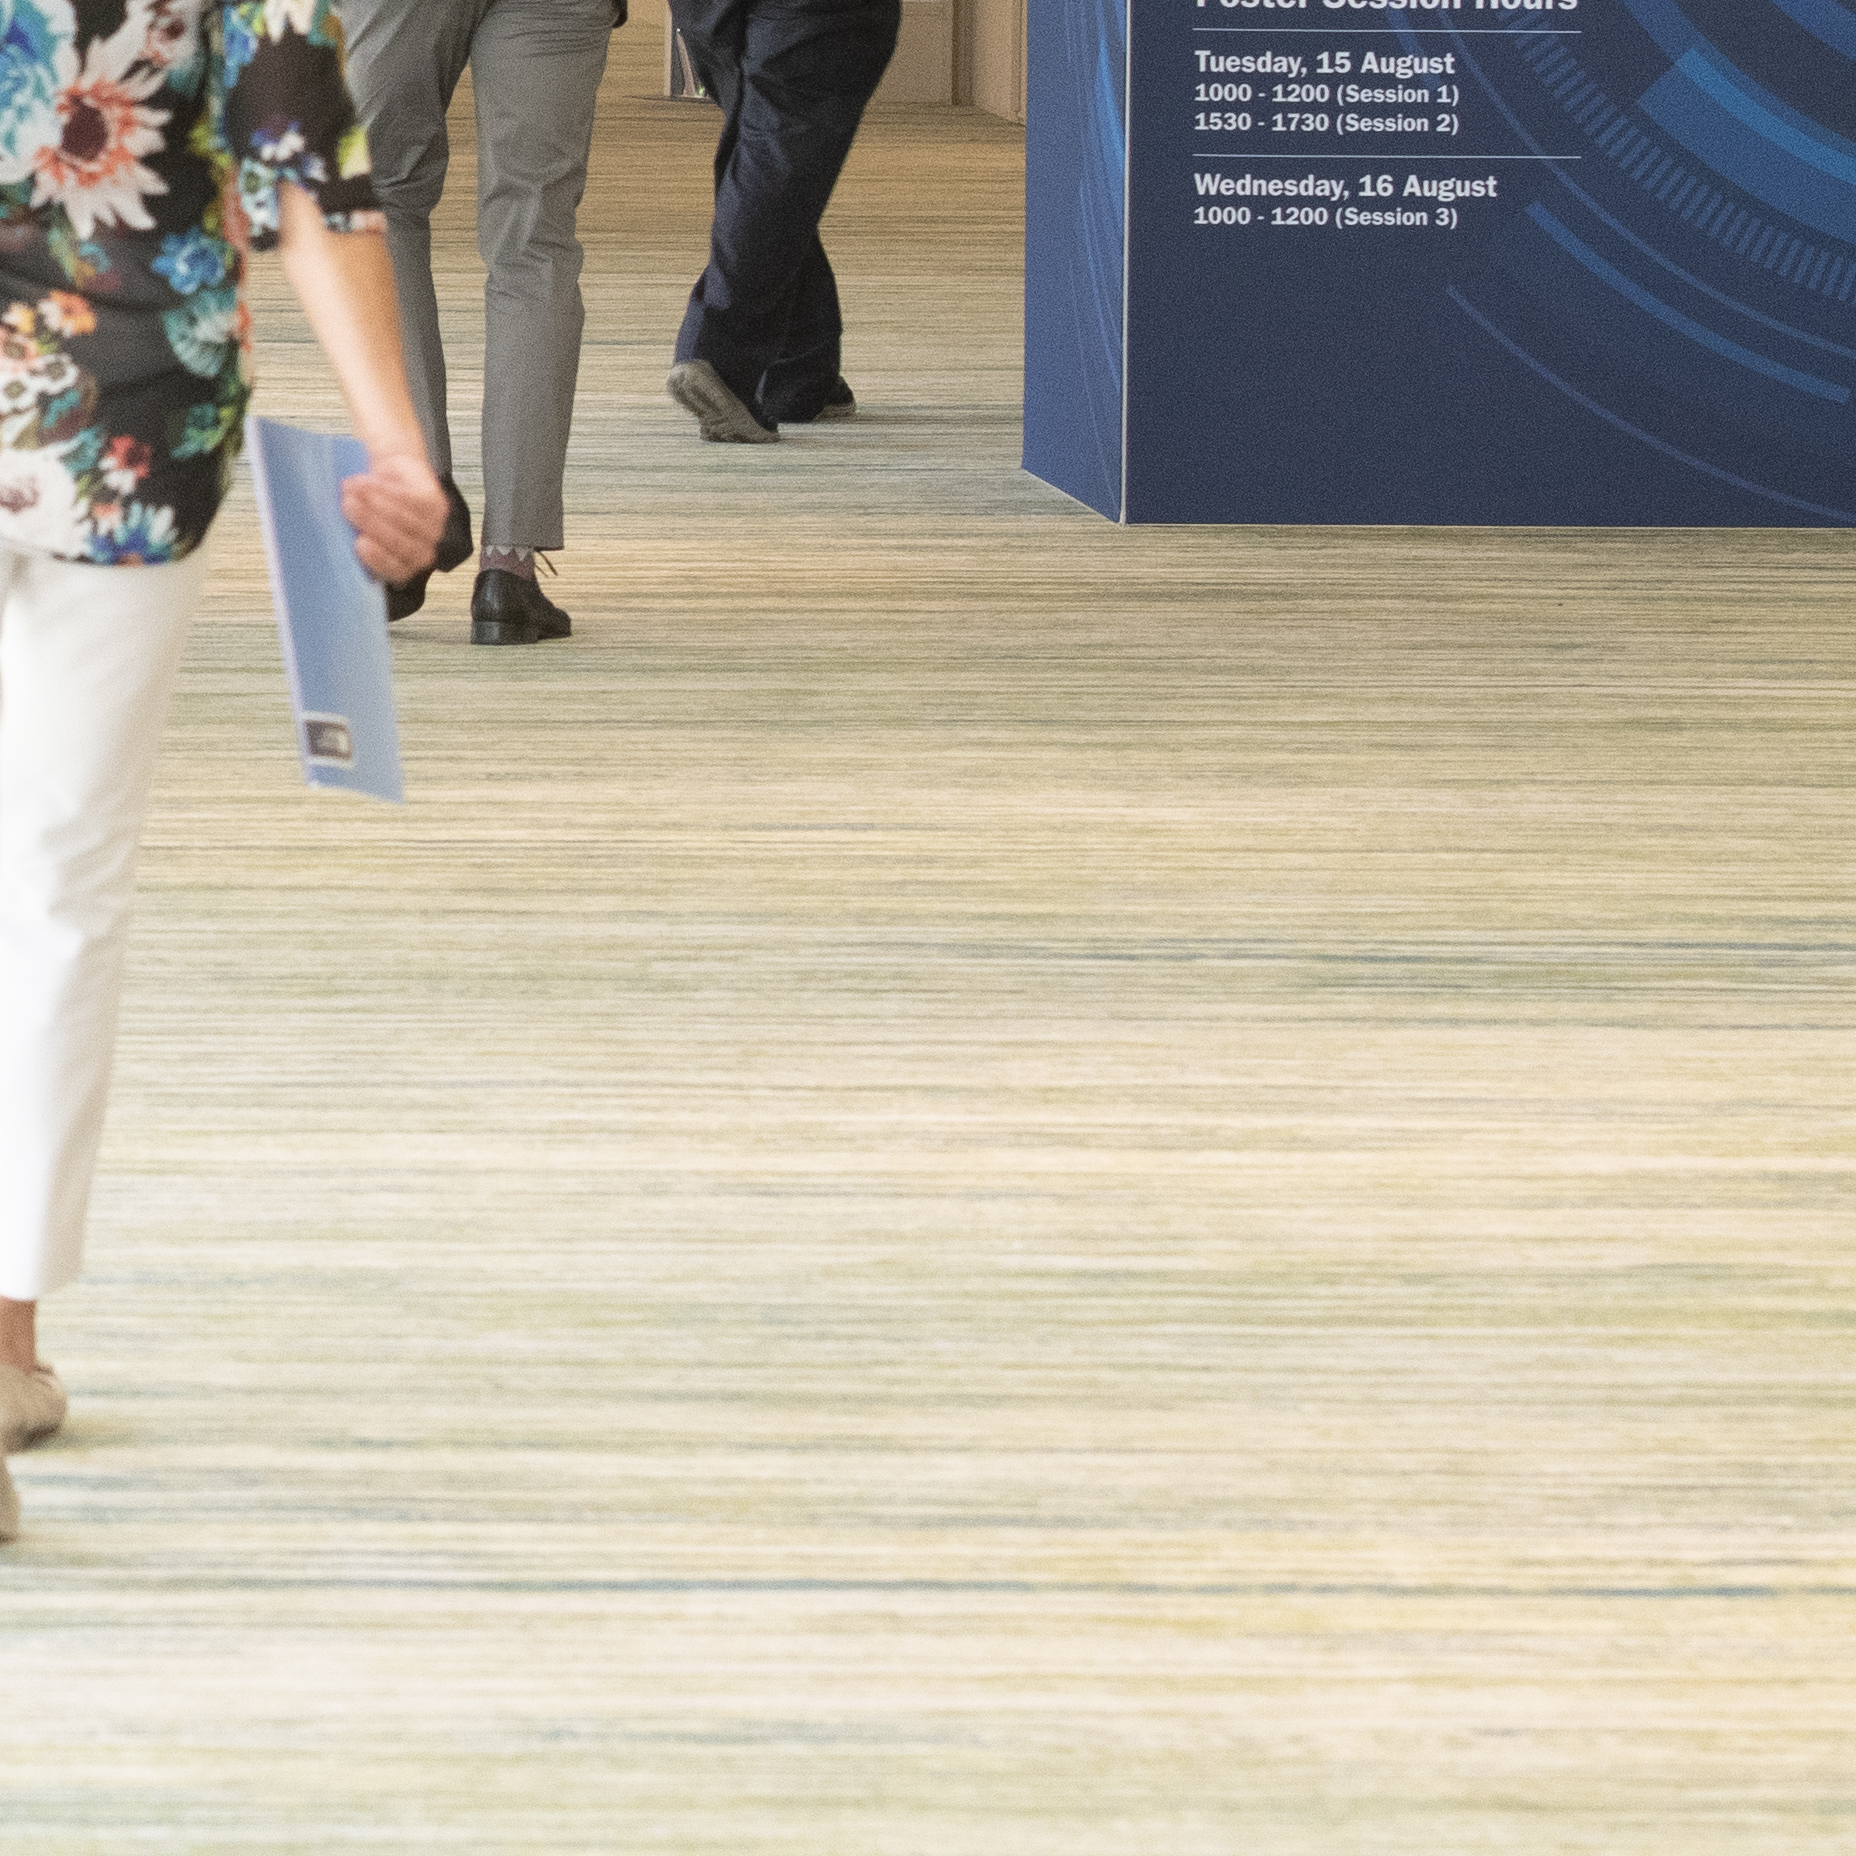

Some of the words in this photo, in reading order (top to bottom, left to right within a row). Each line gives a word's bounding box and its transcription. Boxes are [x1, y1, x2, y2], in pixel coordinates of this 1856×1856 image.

[1195, 50, 1307, 78] Tuesday,
[1316, 51, 1352, 74] 15
[1360, 51, 1455, 79] August
[1195, 83, 1252, 102] 1000
[1272, 84, 1330, 103] 1200
[1337, 84, 1429, 106] (Session
[1437, 85, 1459, 106] 1)
[1195, 112, 1252, 131] 1530
[1272, 113, 1330, 132] 1730
[1336, 113, 1429, 135] (Session
[1436, 113, 1459, 135] 2)
[1194, 173, 1349, 201] Wednesday,
[1359, 174, 1394, 197] 16
[1403, 174, 1497, 202] August
[1194, 206, 1251, 225] 1000
[1271, 207, 1329, 226] 1200
[1335, 207, 1428, 229] (Session
[1435, 207, 1458, 229] 3)
